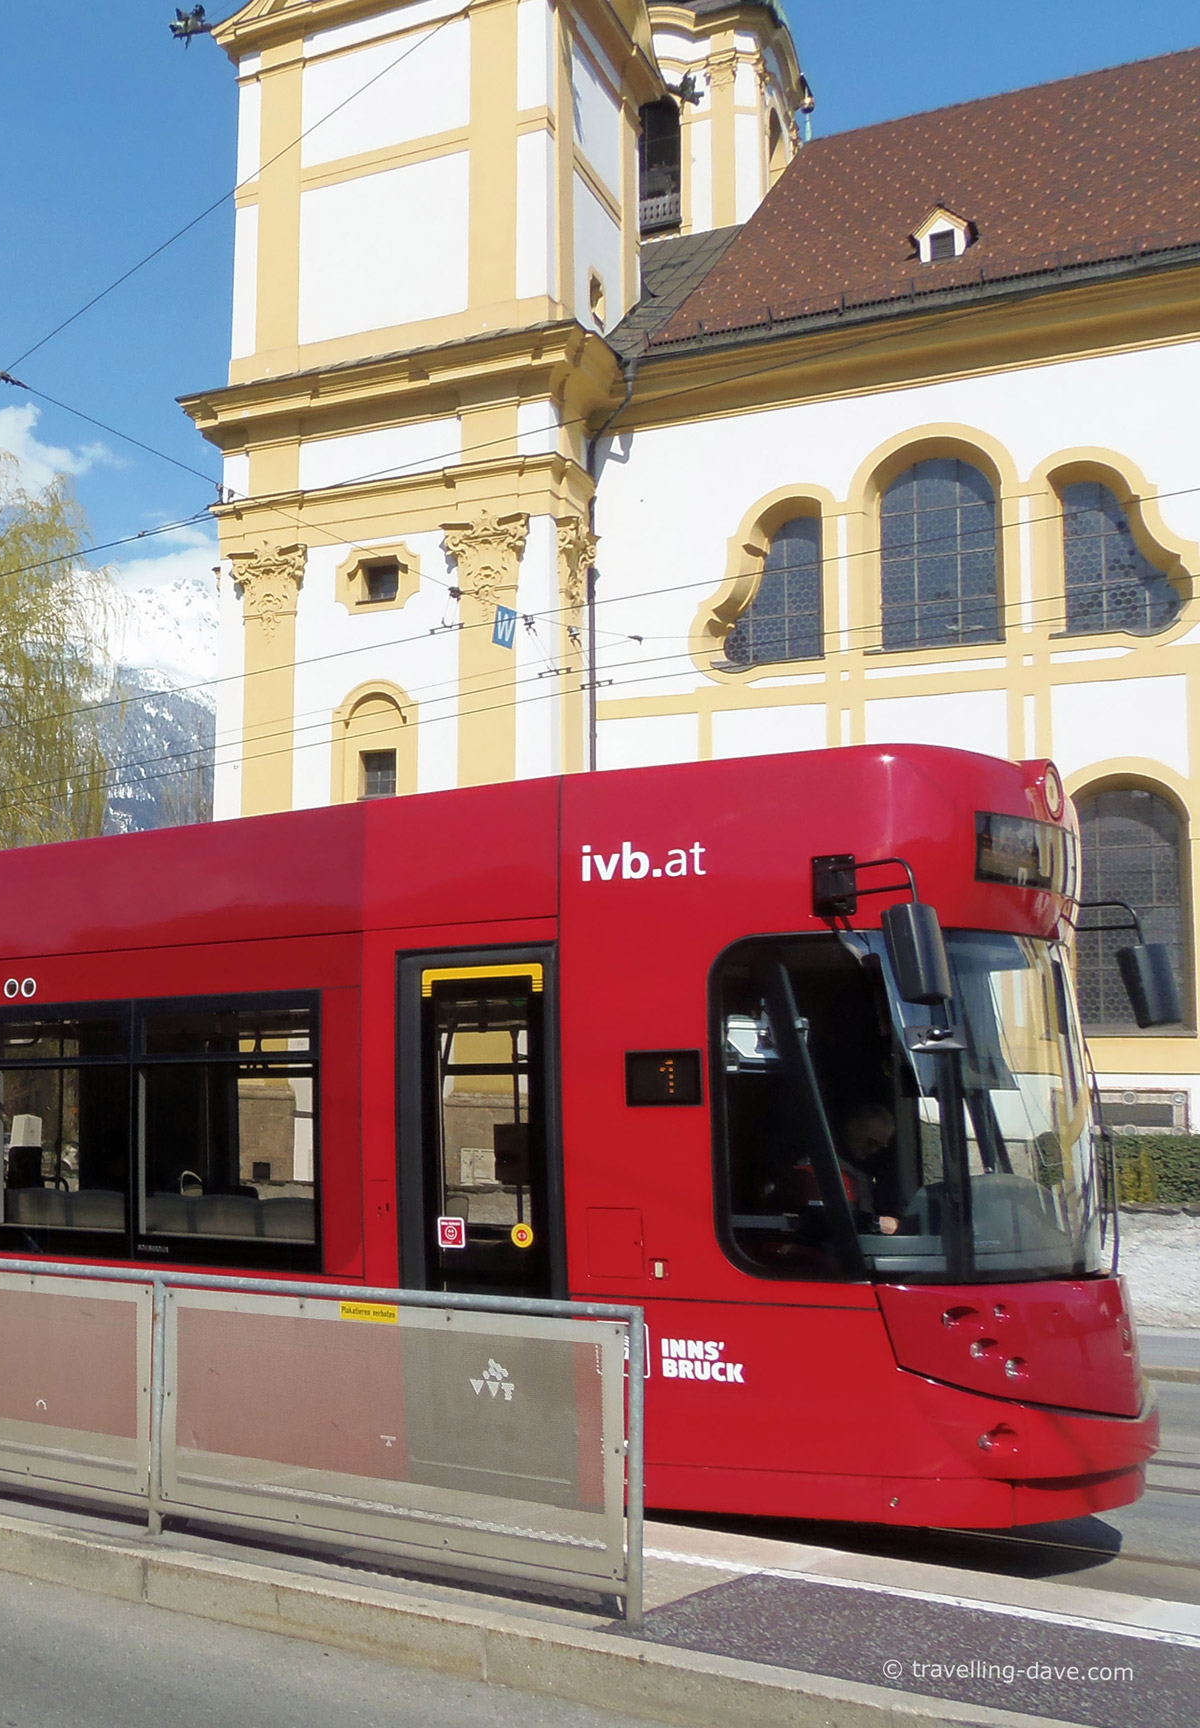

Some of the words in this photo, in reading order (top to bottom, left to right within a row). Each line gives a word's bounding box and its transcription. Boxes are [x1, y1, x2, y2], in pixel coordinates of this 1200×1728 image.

[497, 610, 515, 642] W
[581, 841, 707, 882] ivb.at
[659, 1059, 675, 1094] 1
[372, 1309, 396, 1319] verboten
[662, 1358, 745, 1383] BRUCK
